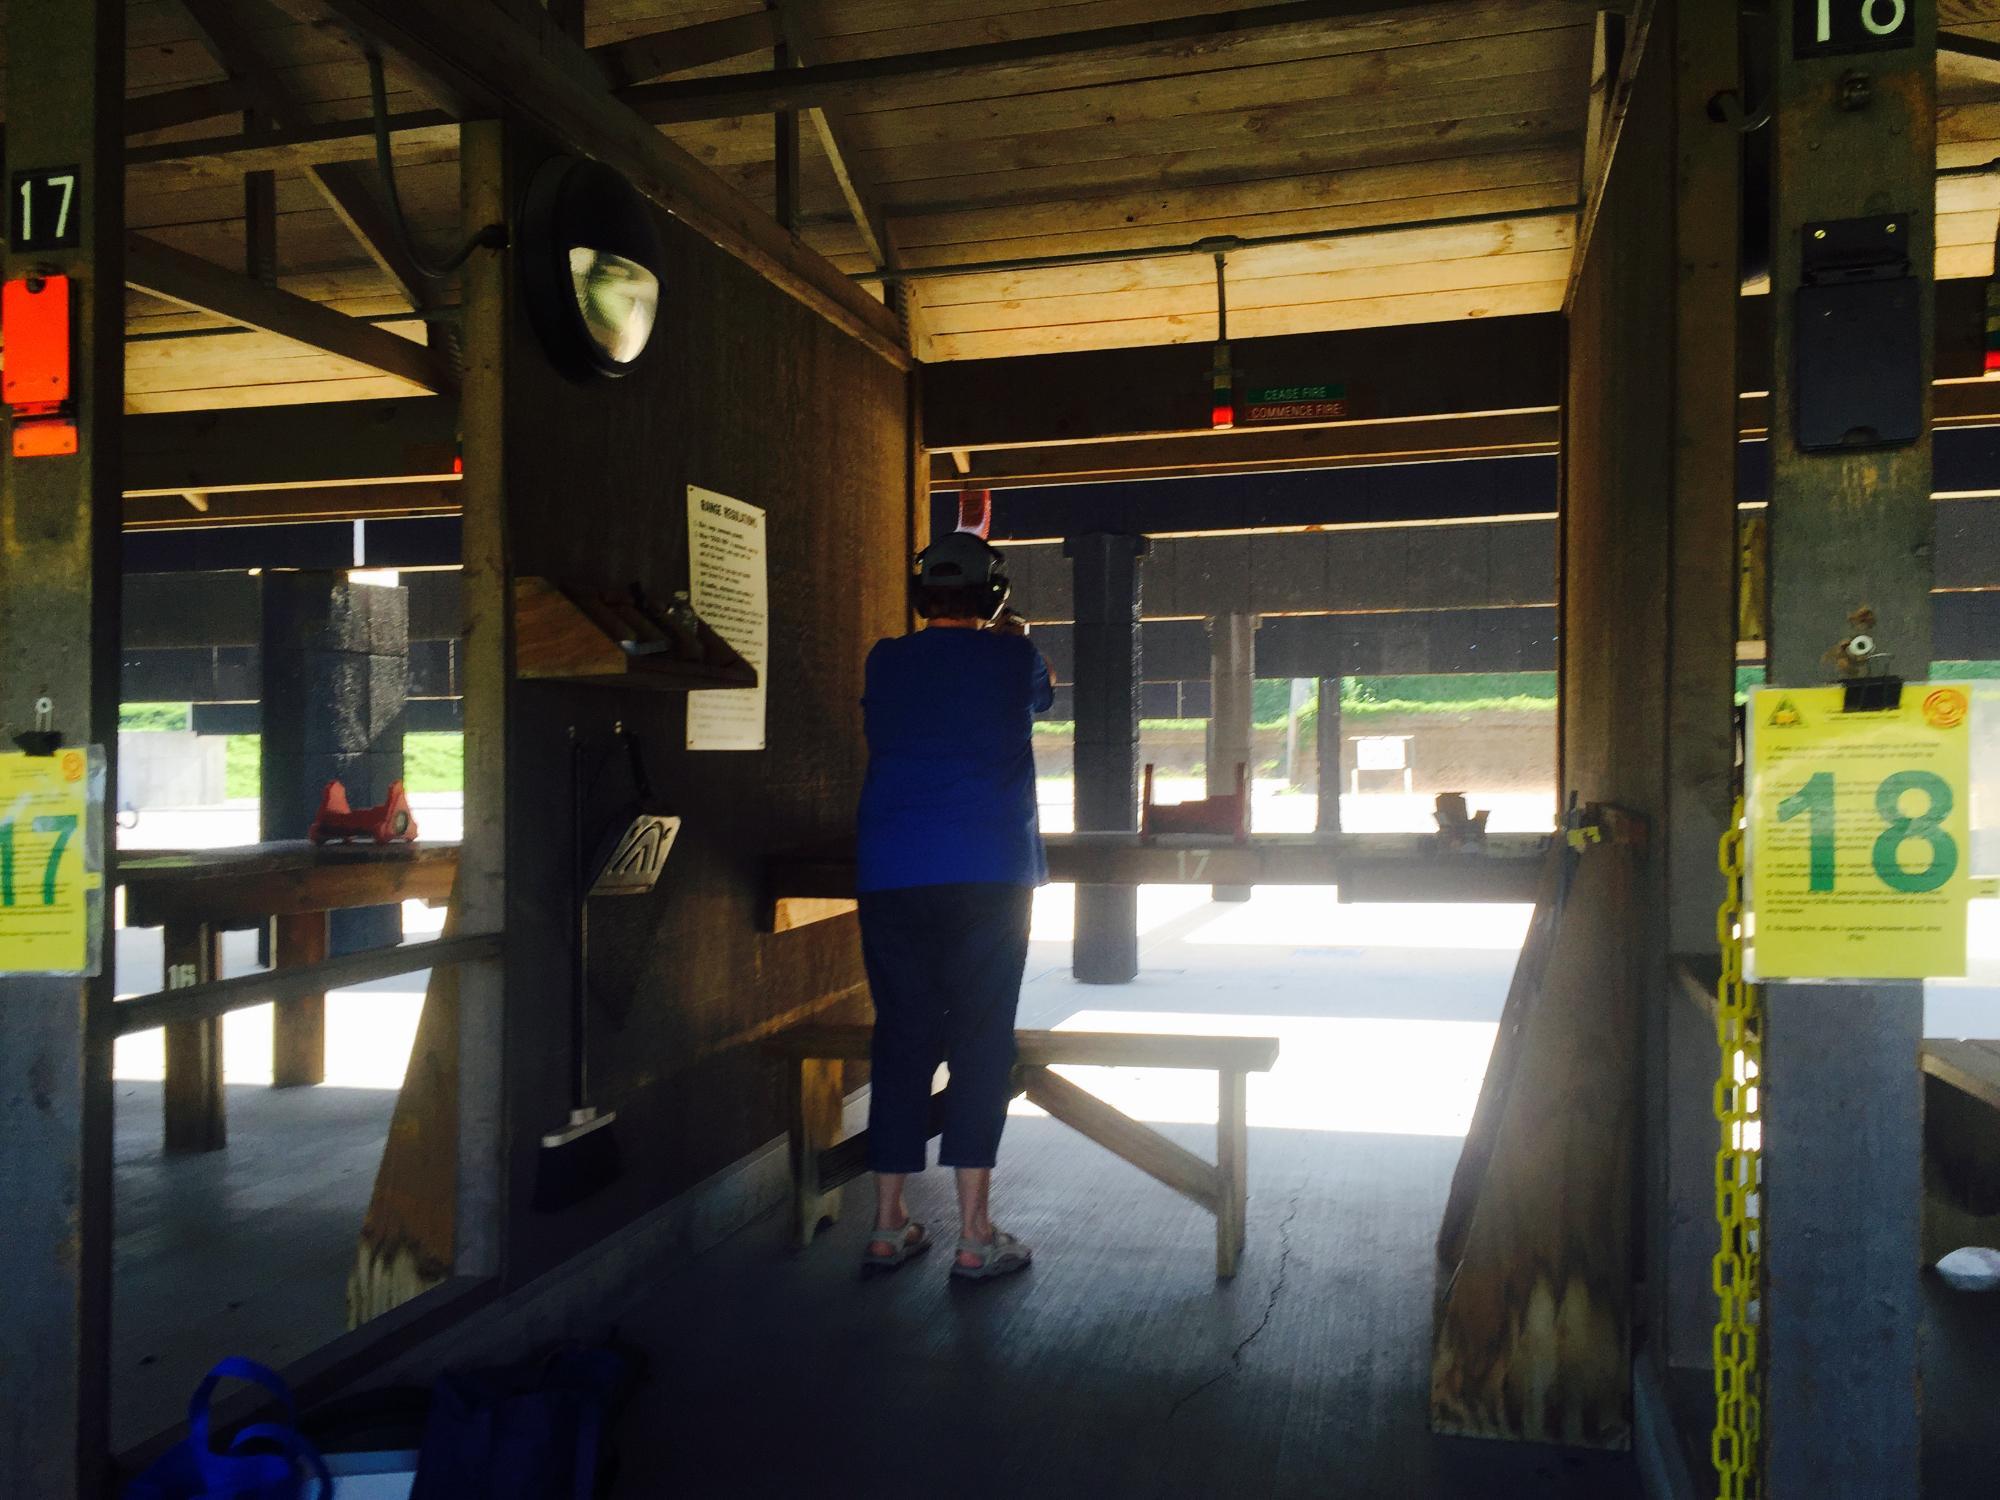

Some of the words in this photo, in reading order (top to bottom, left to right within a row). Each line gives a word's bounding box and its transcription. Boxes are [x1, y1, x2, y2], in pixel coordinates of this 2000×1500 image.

[20, 175, 75, 241] 17
[1264, 387, 1299, 401] CEASE
[1302, 386, 1327, 399] FIRE
[1250, 405, 1312, 419] COMMENCE
[1315, 403, 1342, 416] FIRE
[1776, 769, 1959, 894] 18
[1176, 849, 1211, 882] 17
